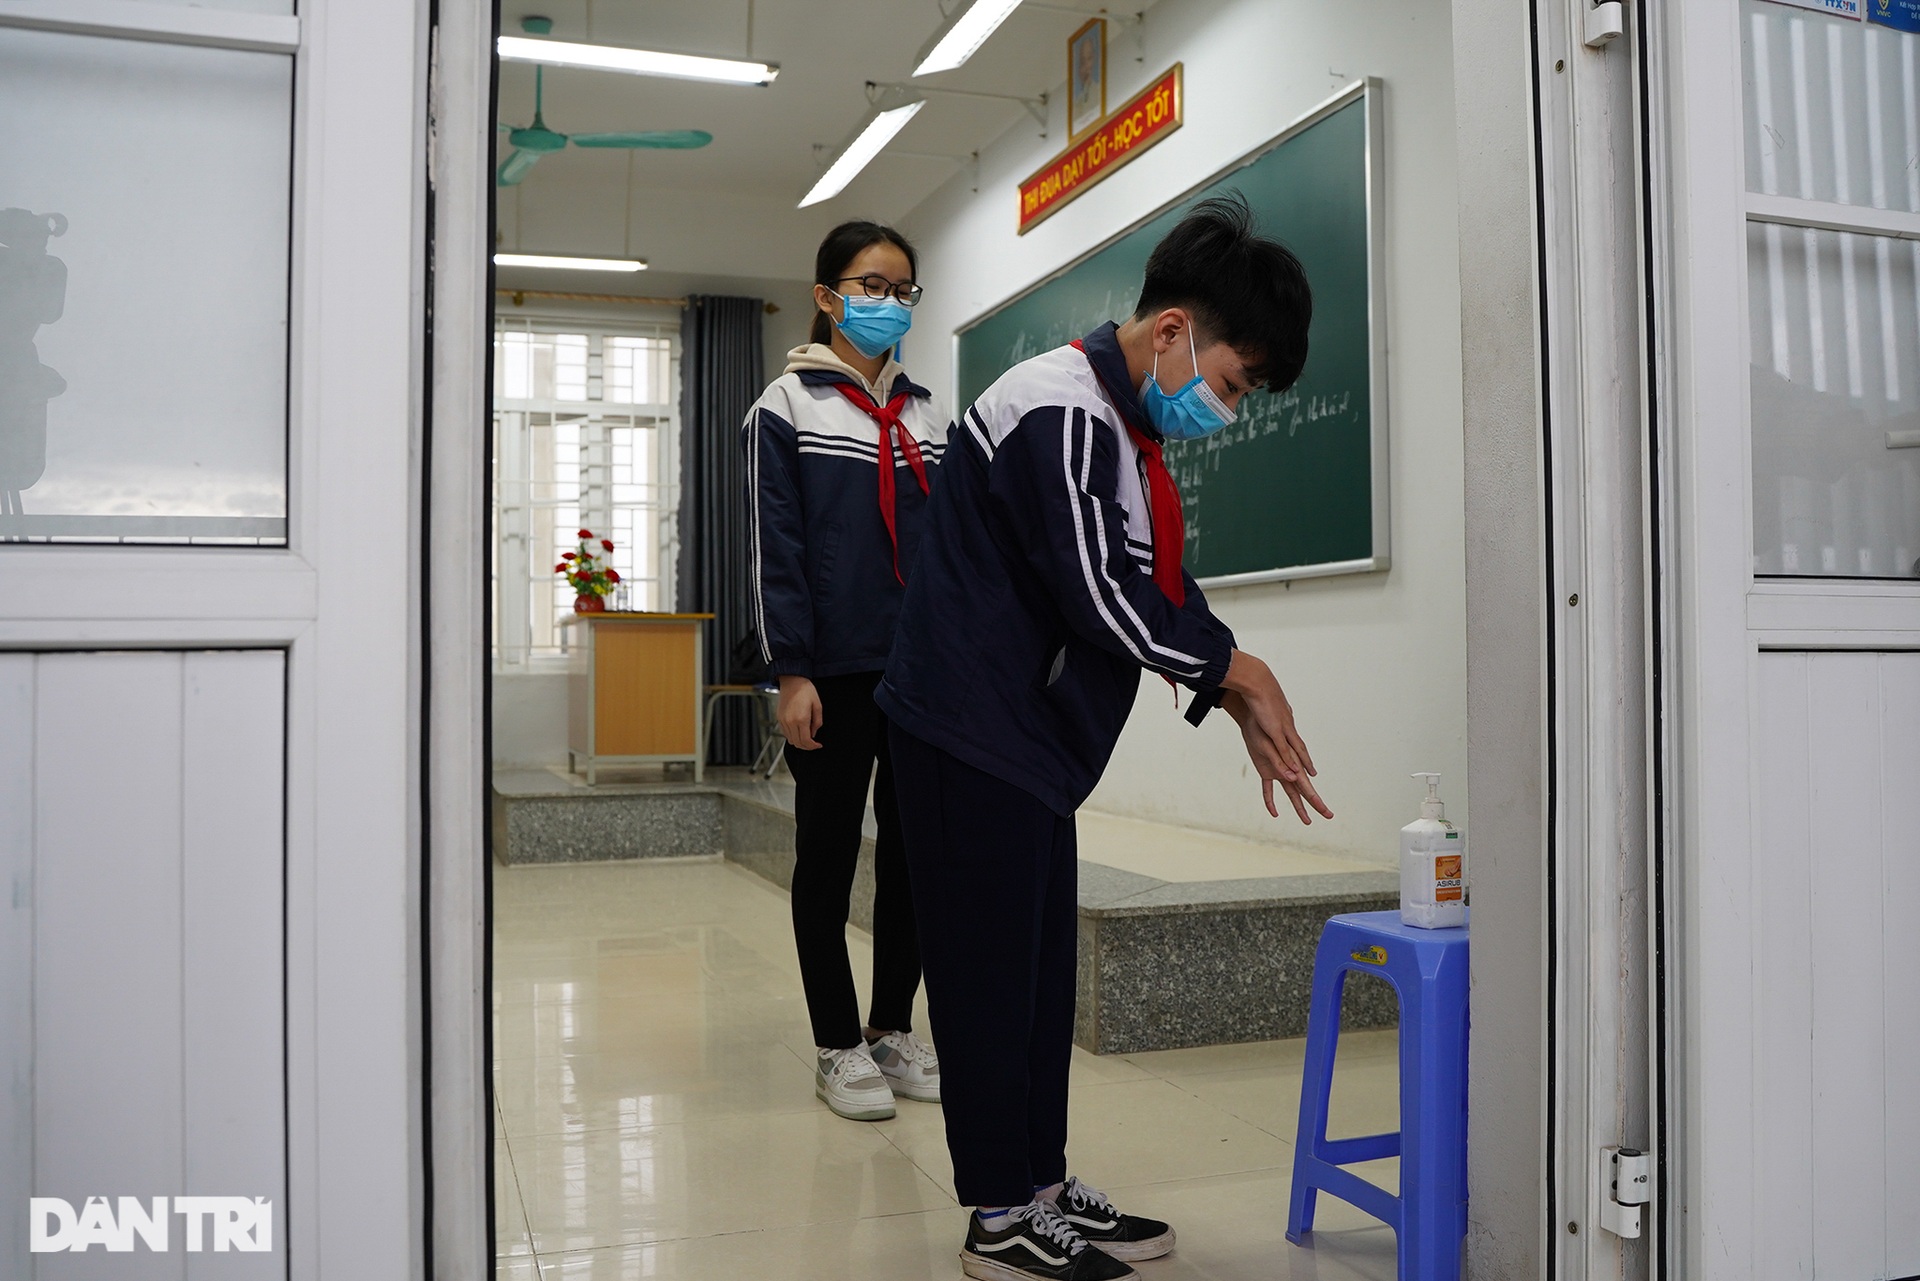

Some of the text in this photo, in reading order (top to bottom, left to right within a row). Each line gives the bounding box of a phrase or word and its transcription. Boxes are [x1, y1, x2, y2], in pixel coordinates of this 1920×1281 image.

[1023, 186, 1039, 215] THI
[1040, 171, 1062, 204] ĐUA
[1062, 152, 1086, 187] DẠY
[1145, 86, 1170, 127] TỐT
